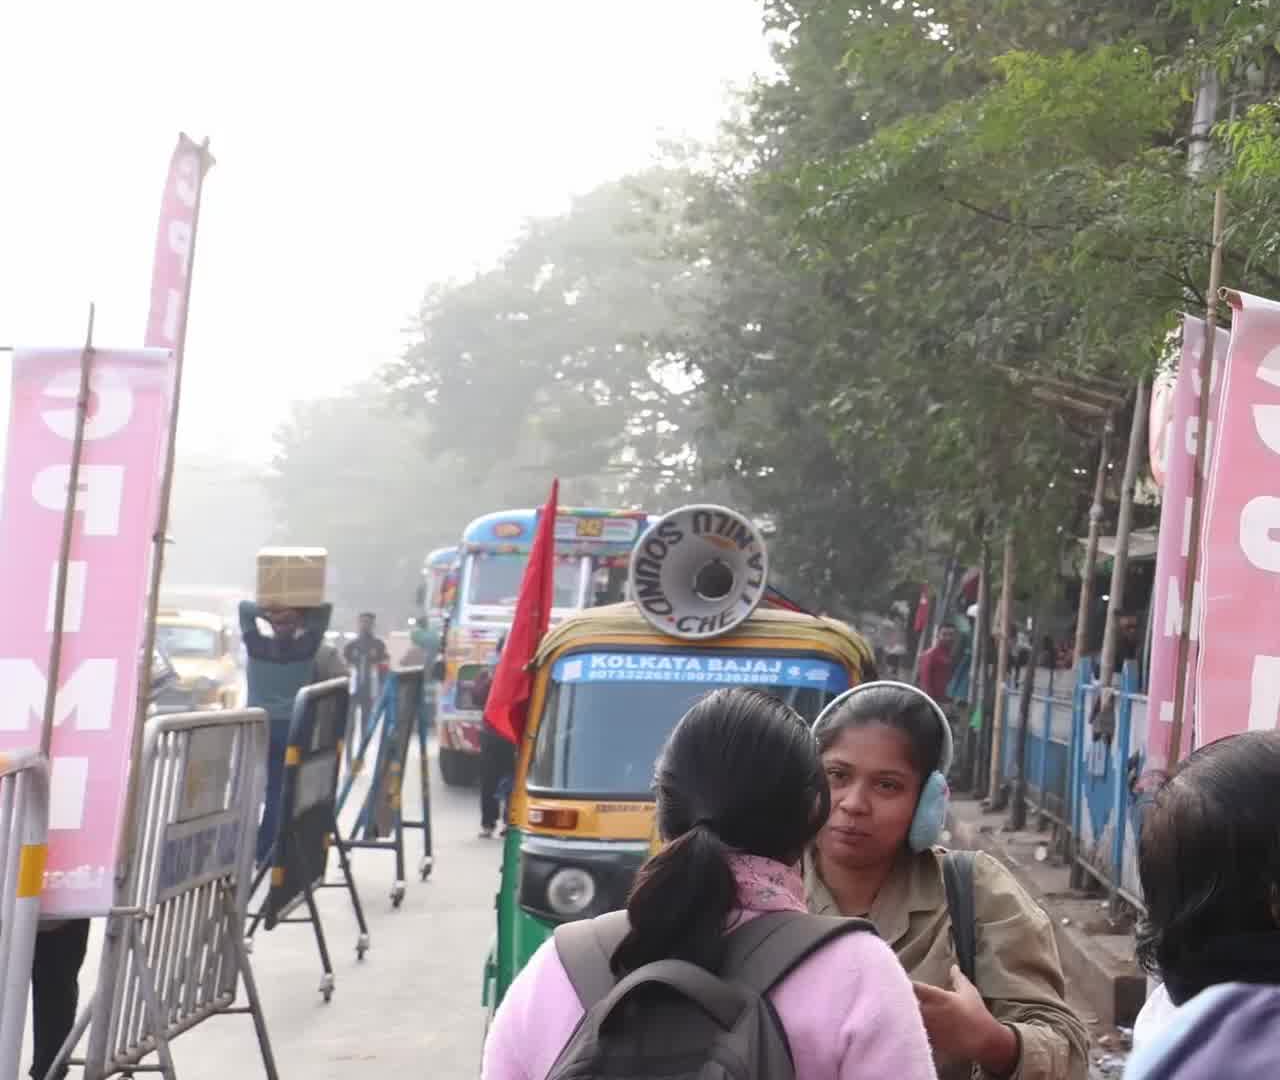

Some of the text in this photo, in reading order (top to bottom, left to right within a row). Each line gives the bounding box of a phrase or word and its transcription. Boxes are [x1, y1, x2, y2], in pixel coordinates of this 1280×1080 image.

[634, 520, 684, 616] SOUND
[591, 655, 782, 674] KOLKATA BAJAJ
